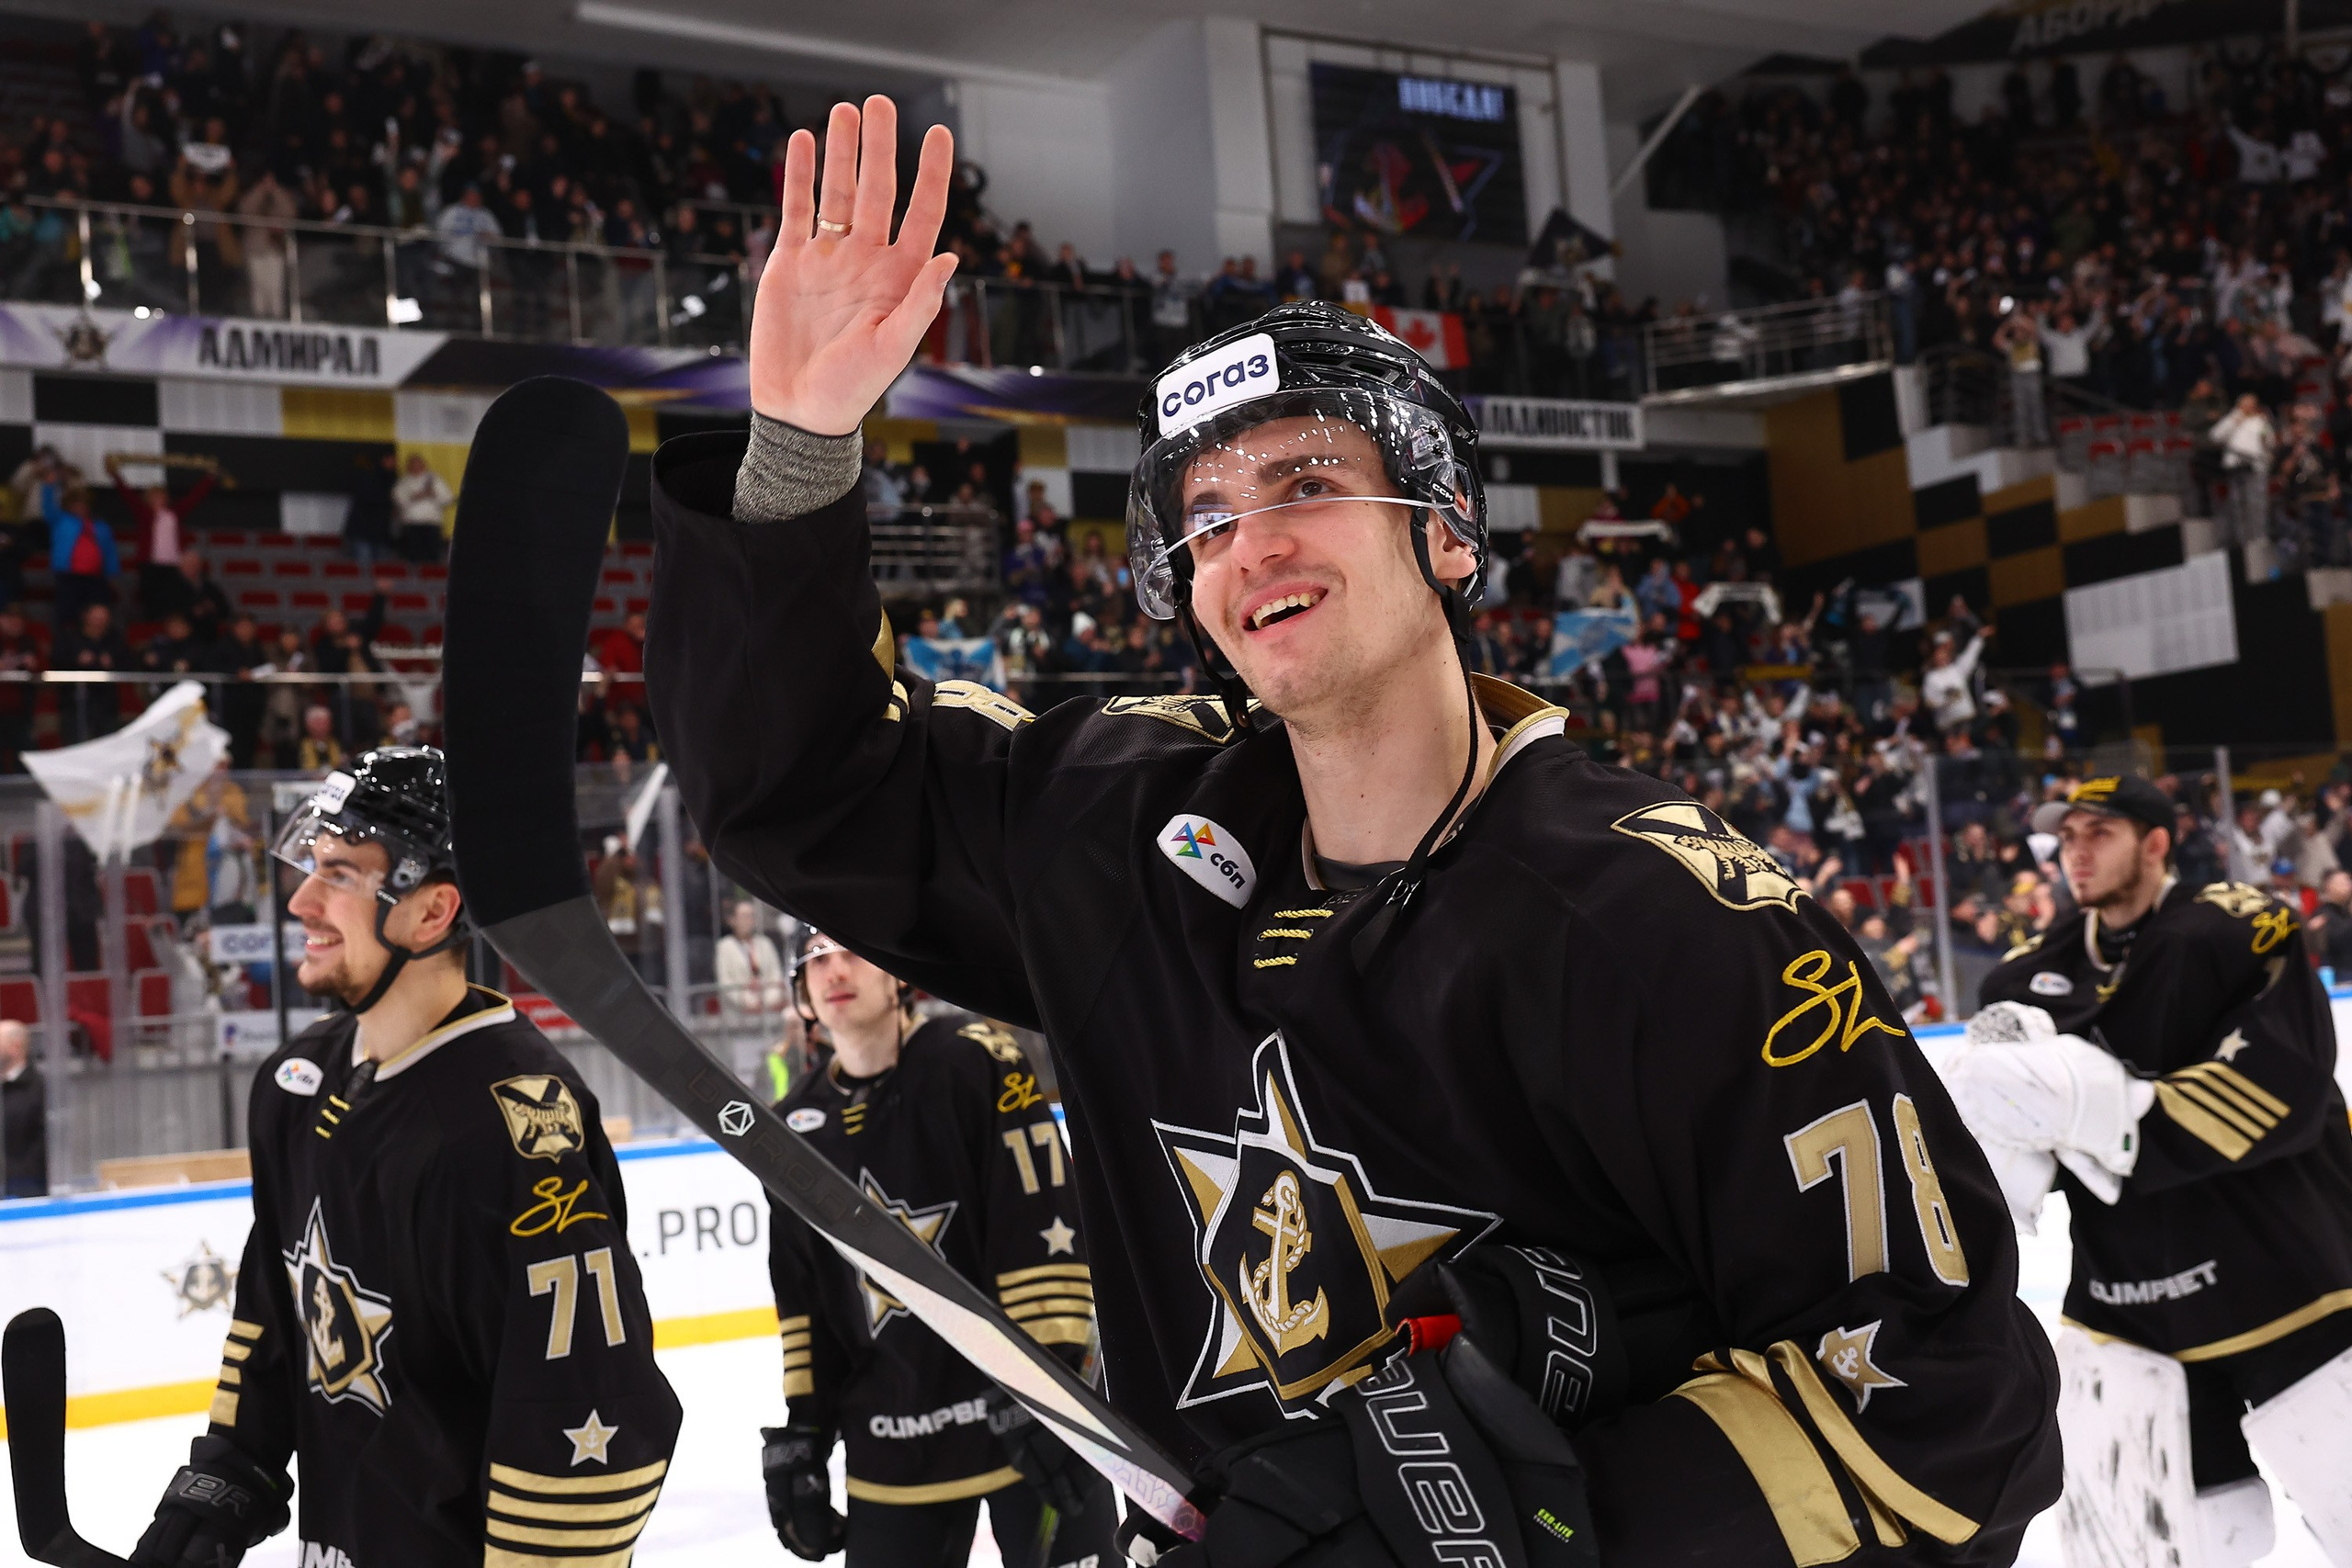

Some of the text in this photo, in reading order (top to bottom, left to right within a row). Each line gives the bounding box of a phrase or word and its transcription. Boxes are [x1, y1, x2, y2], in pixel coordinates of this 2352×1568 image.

[198, 326, 379, 375] АДМИРАЛ
[1431, 482, 1453, 502] CCM
[1001, 1120, 1067, 1195] 17
[1782, 1091, 1970, 1287] 78
[526, 1246, 627, 1360] 71
